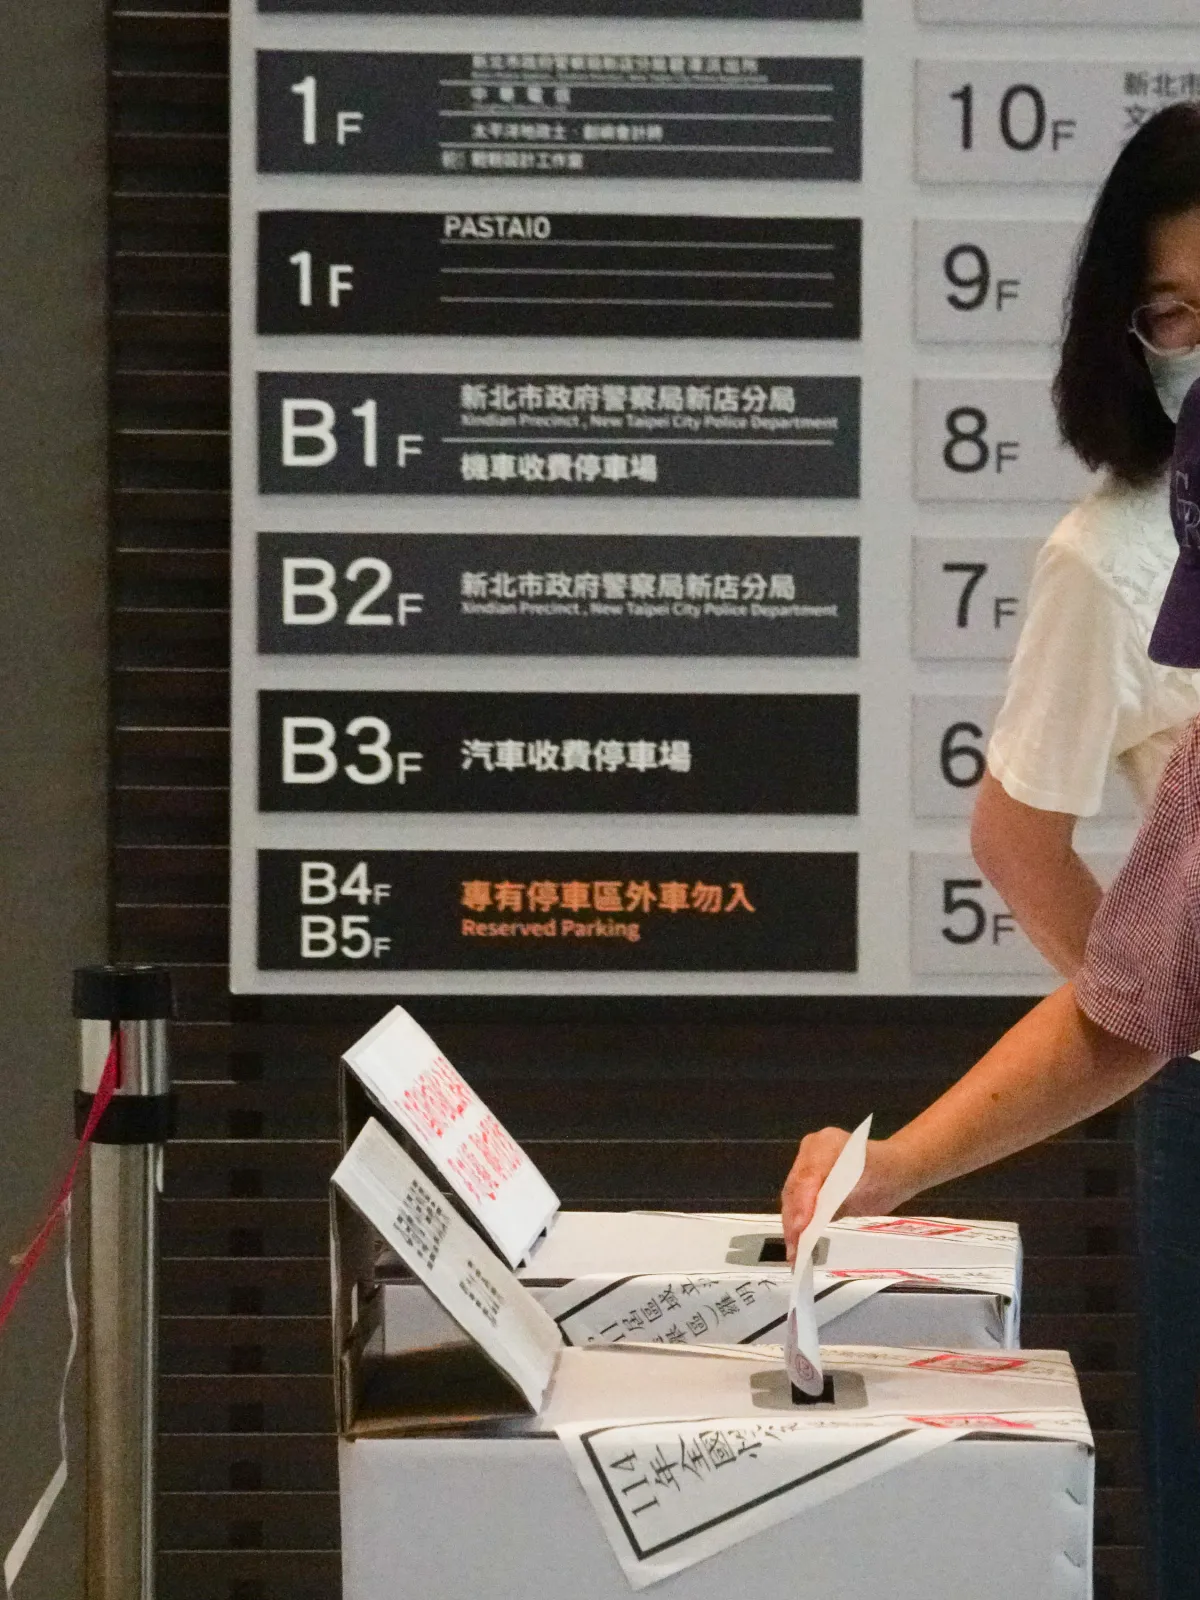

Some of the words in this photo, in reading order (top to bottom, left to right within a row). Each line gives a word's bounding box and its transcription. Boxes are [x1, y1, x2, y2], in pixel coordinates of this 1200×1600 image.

[290, 76, 363, 145] 1F
[948, 84, 1076, 152] 10F
[444, 216, 551, 239] PASTAIO
[289, 251, 353, 307] 1F
[943, 244, 1020, 312] 9F
[461, 384, 796, 413] 新北市政府警察局新店分局
[281, 398, 424, 467] B1F
[943, 406, 1020, 474] 8F
[282, 557, 424, 626] B2F
[461, 571, 796, 600] 新北市政府警察局新店分局
[942, 562, 1018, 628] 7F
[282, 716, 424, 785] B3F
[461, 739, 692, 773] 汽車收費停車場
[300, 861, 391, 905] B4F
[461, 881, 755, 913] 專有停車區外車勿入
[300, 915, 391, 959] B5F
[461, 918, 557, 937] Reserved
[562, 919, 640, 943] Parking
